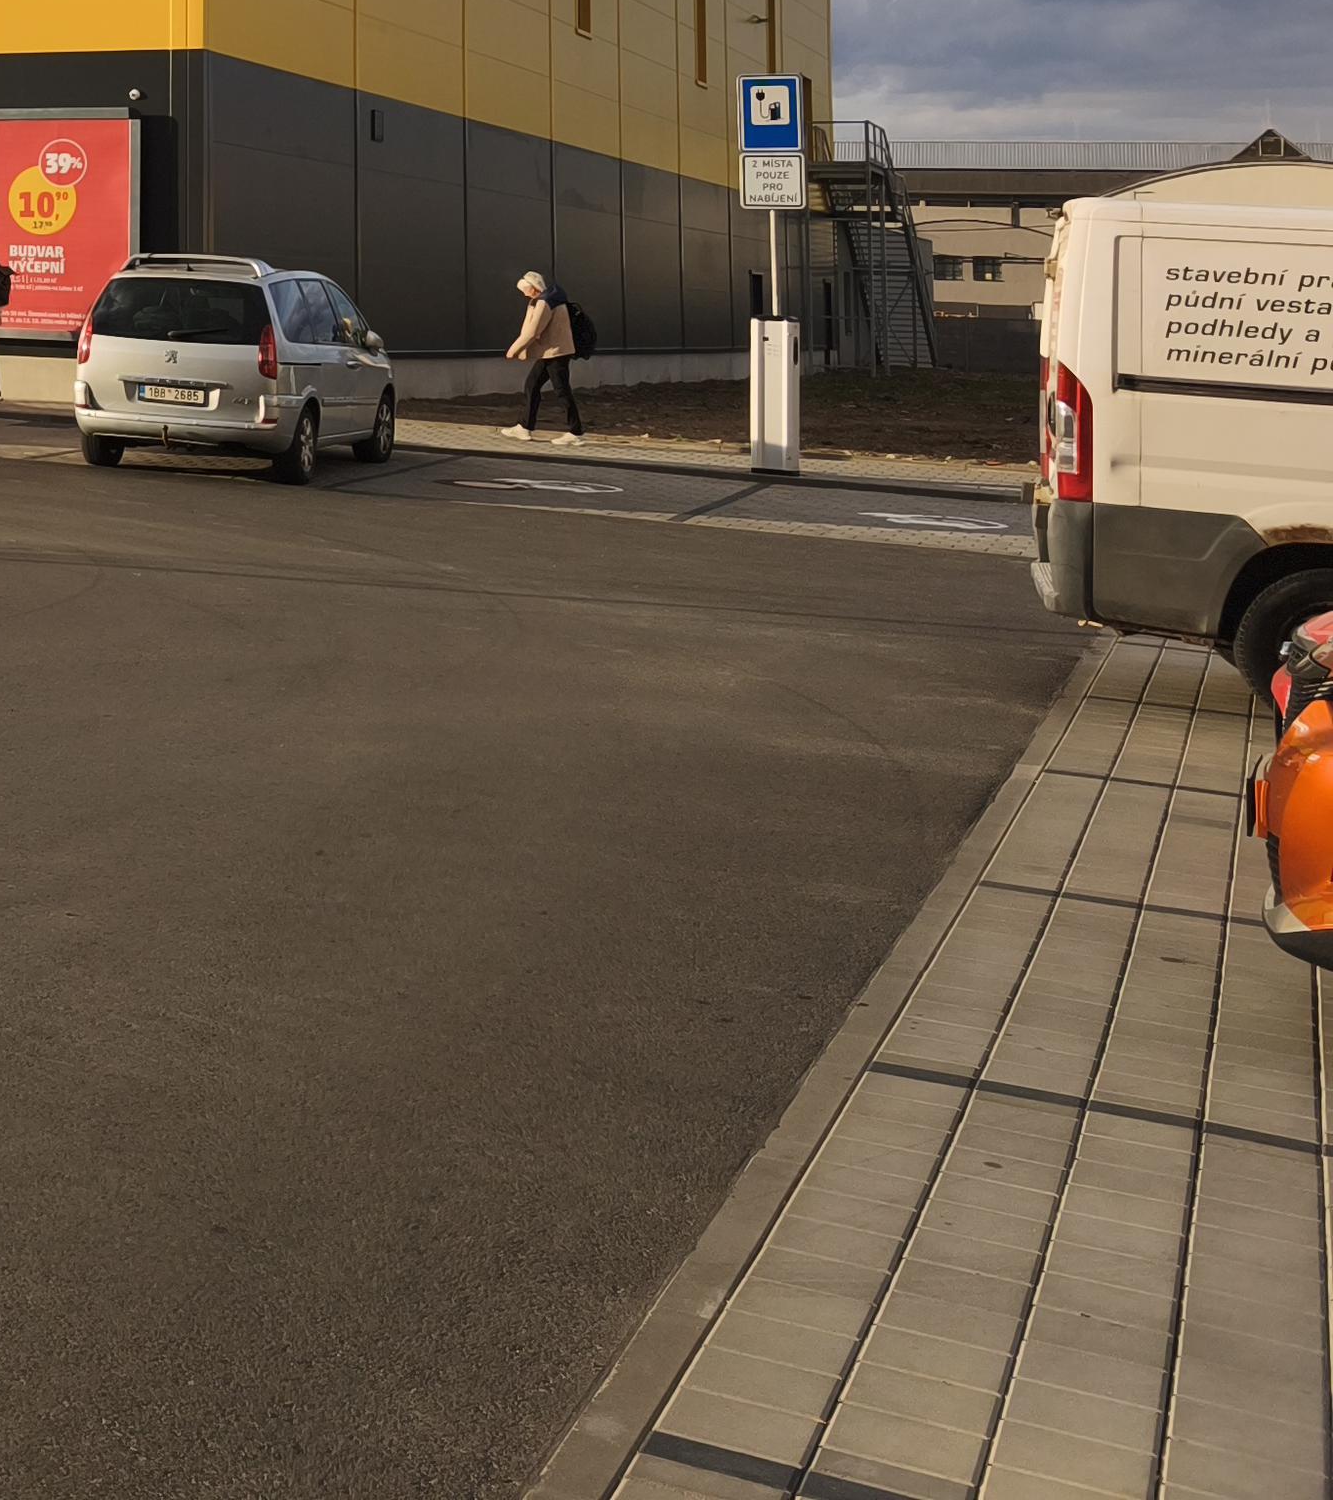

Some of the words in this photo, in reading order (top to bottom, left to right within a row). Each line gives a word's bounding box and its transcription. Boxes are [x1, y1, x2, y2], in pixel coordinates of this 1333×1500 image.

[45, 152, 83, 174] 39%
[752, 160, 758, 168] 2
[762, 158, 793, 168] MÍSTA
[755, 171, 790, 180] POUZE
[762, 182, 783, 191] PRO
[749, 192, 798, 203] NABÍJENÍ
[9, 245, 64, 258] BUDVAR
[9, 257, 65, 274] VÝČEPNÍ
[1166, 266, 1289, 286] stavební
[1165, 290, 1247, 311] půdní
[1165, 318, 1293, 345] podhledy
[1305, 328, 1321, 343] a
[1166, 344, 1303, 369] minerální
[174, 389, 199, 401] 2685
